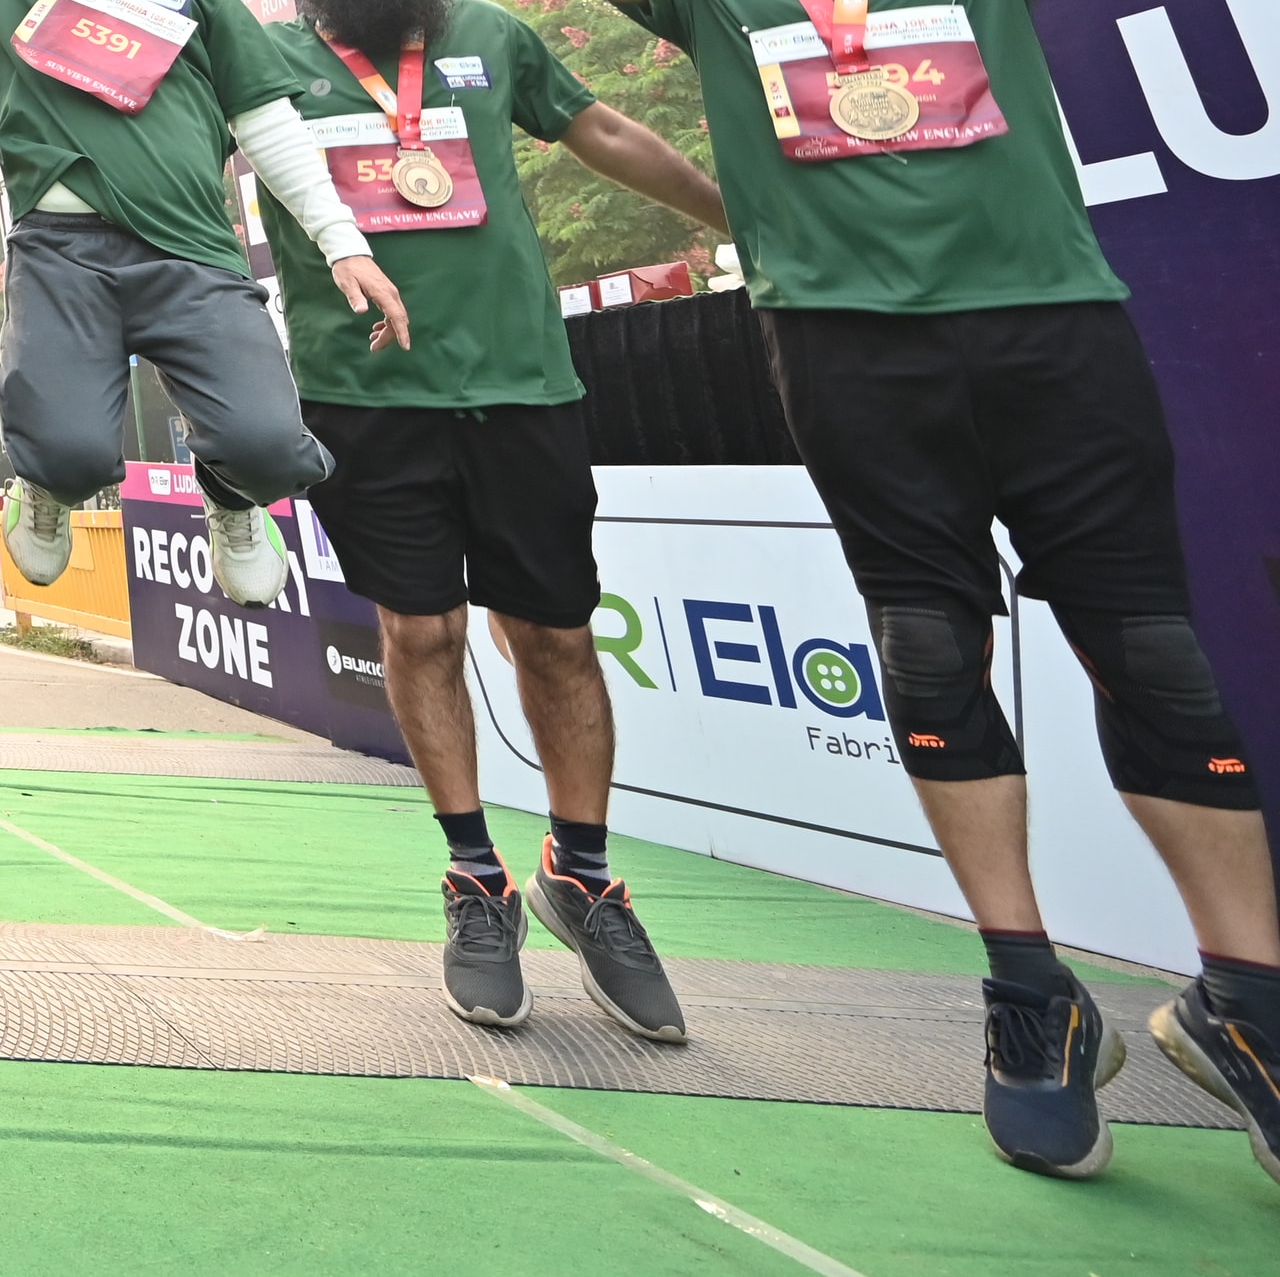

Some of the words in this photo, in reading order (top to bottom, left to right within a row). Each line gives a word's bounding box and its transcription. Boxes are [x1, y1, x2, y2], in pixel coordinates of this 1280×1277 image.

[70, 18, 142, 60] 5391
[905, 19, 926, 28] 10K
[931, 17, 958, 26] RUN
[45, 60, 66, 73] SUN
[67, 68, 93, 84] VIEW
[92, 81, 137, 109] ENCLAVE
[357, 159, 393, 182] 53
[370, 215, 392, 225] SUN
[394, 213, 423, 223] VIEW
[426, 209, 480, 221] ENCLAVE
[133, 526, 311, 617] RECOY
[175, 603, 273, 689] ZONE
[682, 598, 887, 722] Ela
[342, 655, 385, 678] BUKK
[806, 726, 901, 765] Fabri
